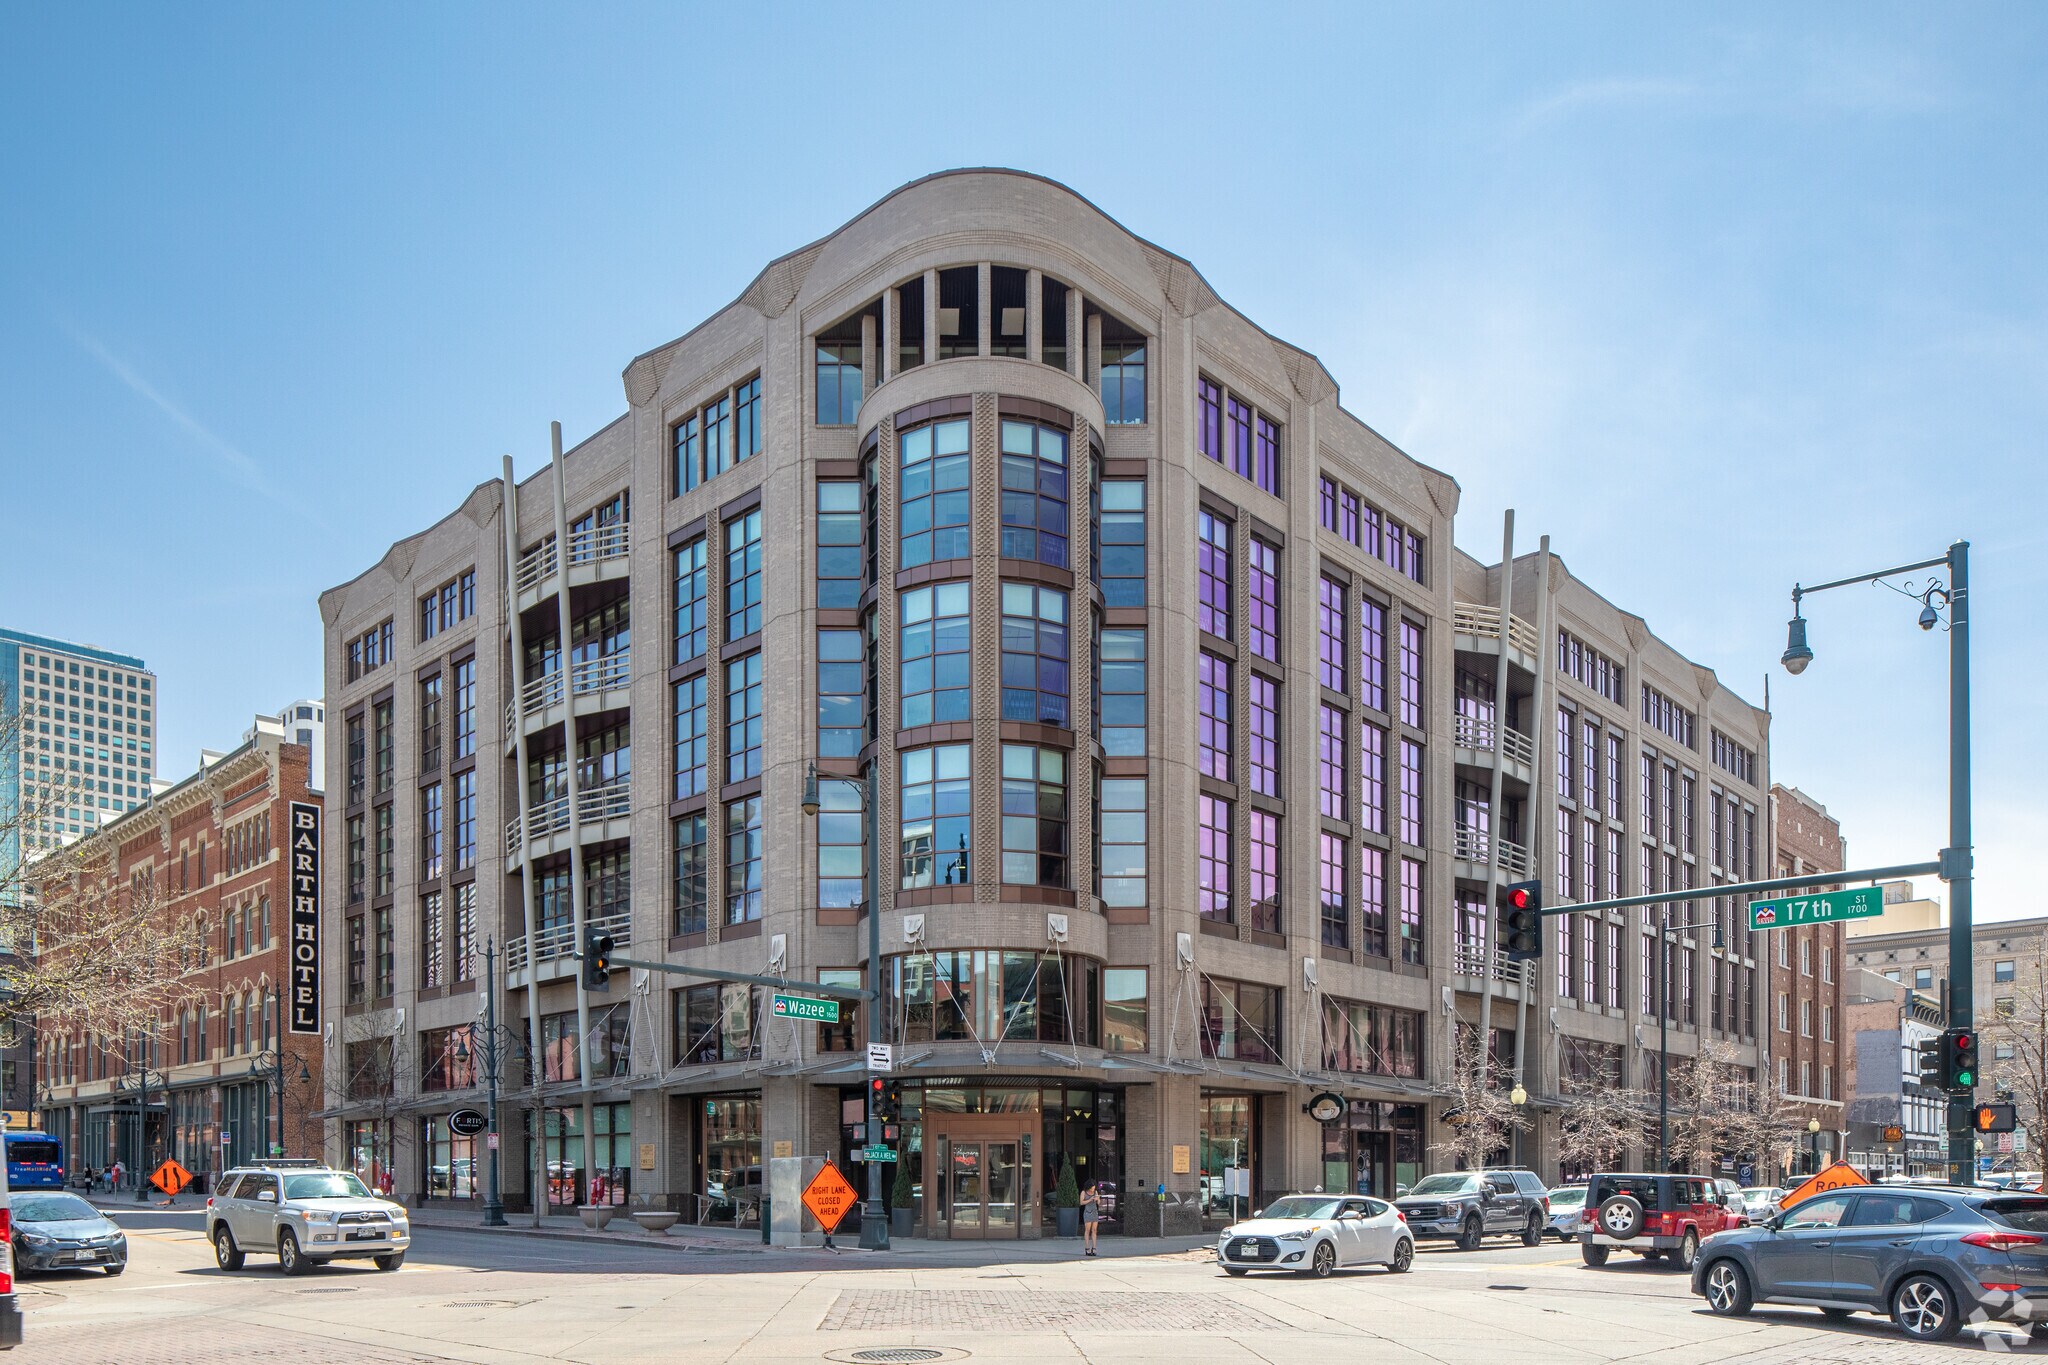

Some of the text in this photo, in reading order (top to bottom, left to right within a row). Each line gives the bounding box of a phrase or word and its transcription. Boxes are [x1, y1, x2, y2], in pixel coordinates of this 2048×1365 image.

[1855, 895, 1866, 904] ST
[1786, 899, 1832, 921] 17th
[1847, 904, 1868, 914] 1700
[294, 811, 316, 1025] BARTH HOTEL
[788, 1000, 825, 1017] Wazee
[811, 1186, 846, 1195] RIGHT LANE
[1815, 1181, 1860, 1193] RO
[817, 1196, 841, 1205] CLOSED
[819, 1207, 839, 1216] AHEAD
